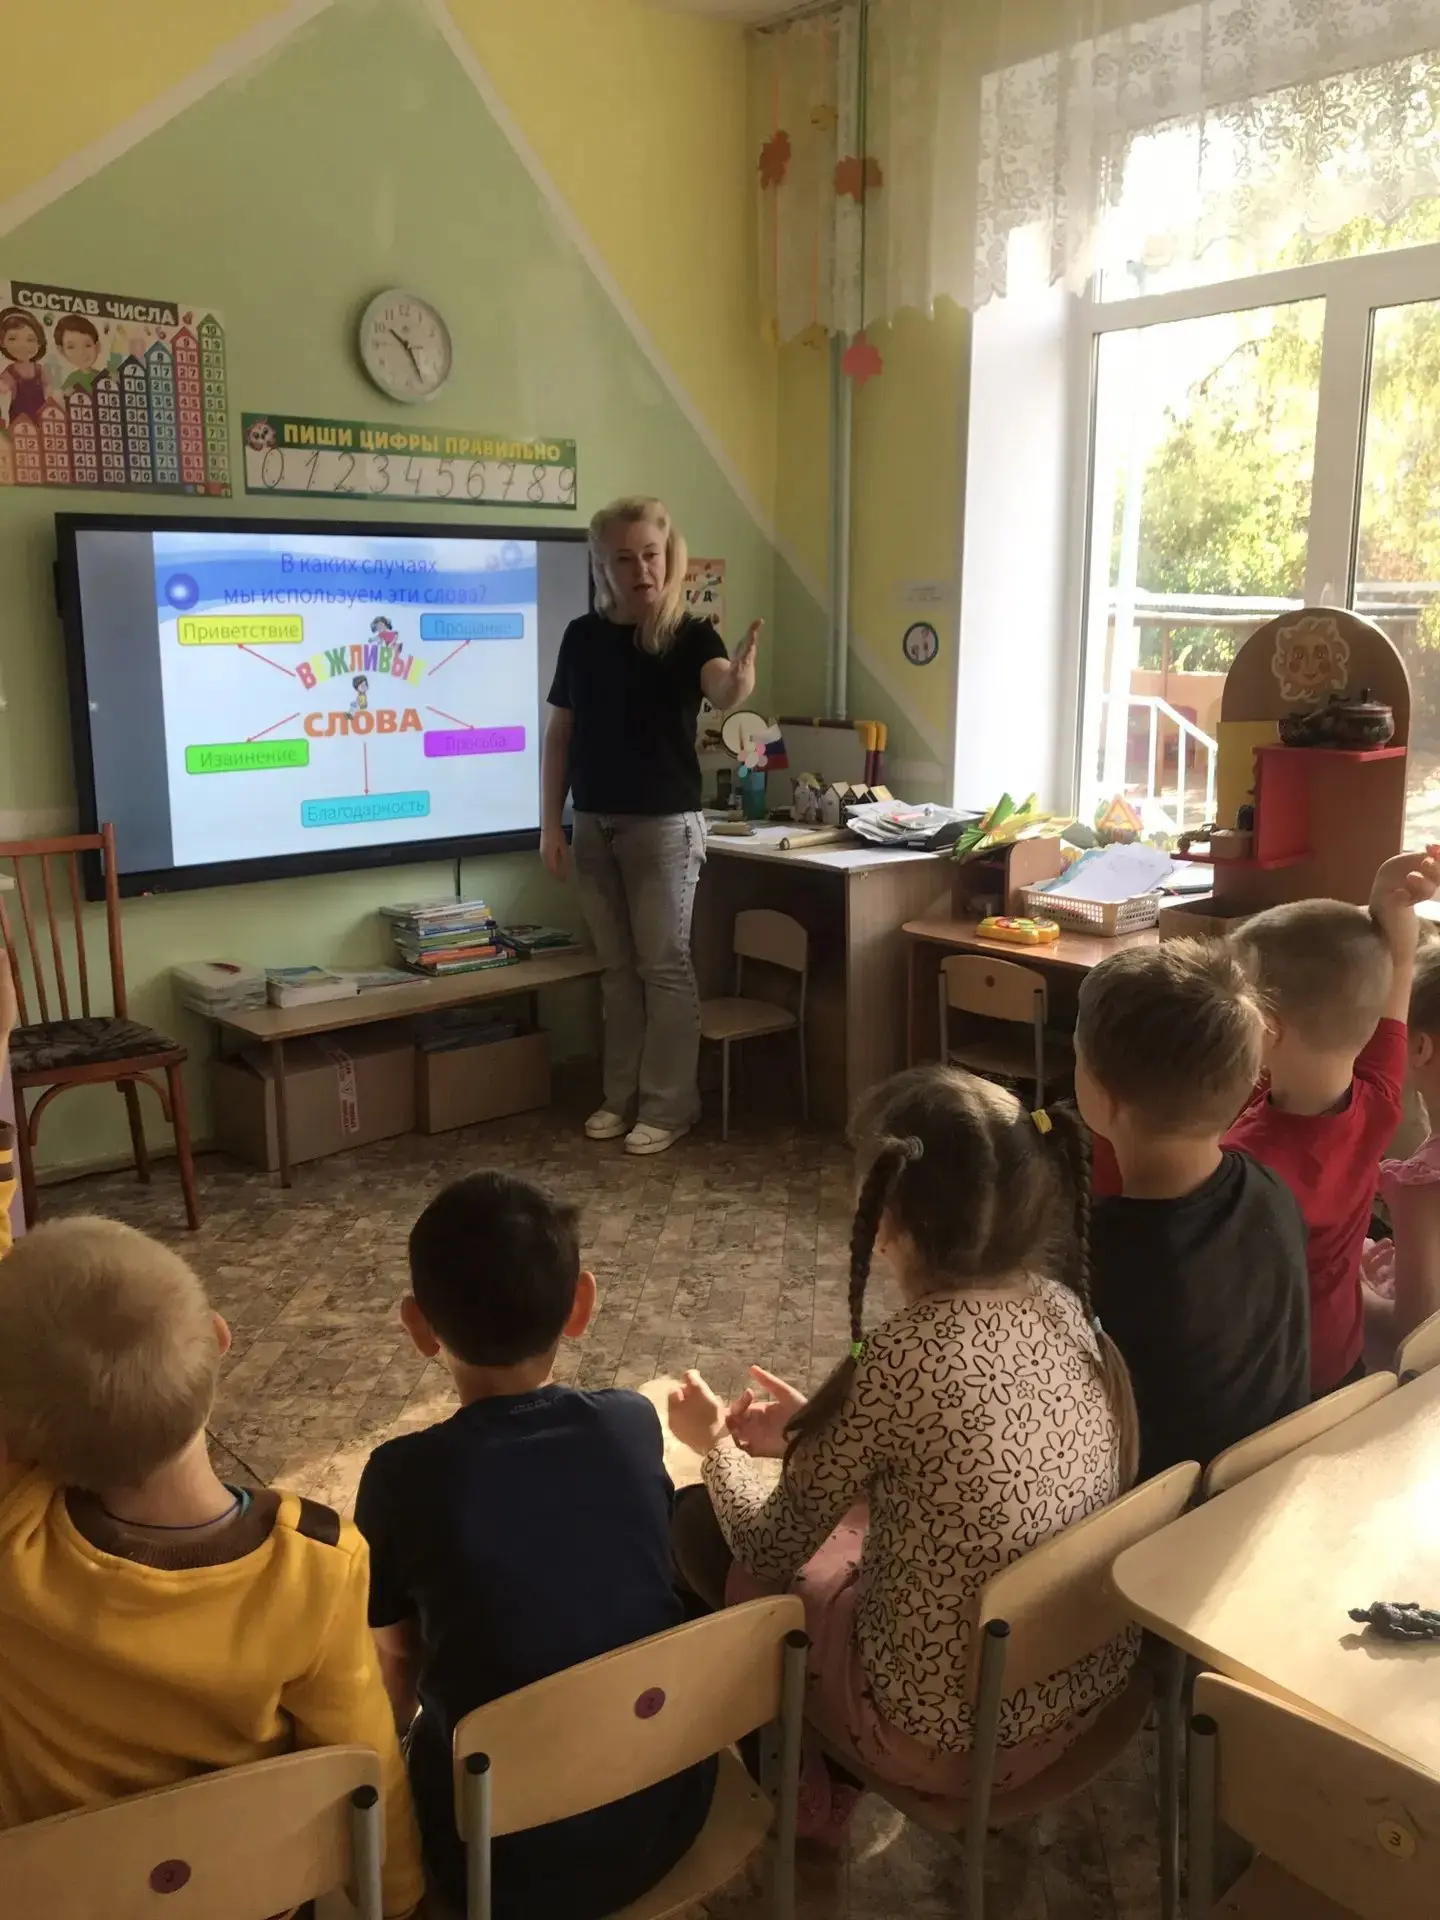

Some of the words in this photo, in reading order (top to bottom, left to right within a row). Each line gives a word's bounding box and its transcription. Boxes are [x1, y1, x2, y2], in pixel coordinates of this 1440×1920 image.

[17, 289, 100, 315] СОСТАВ
[105, 301, 176, 325] ЧИСЛА
[284, 423, 352, 446] ПИШИ
[359, 430, 439, 452] ЦИФРЫ
[445, 436, 560, 461] ПРАВИЛЬНО
[262, 447, 284, 489] 0
[305, 450, 319, 491] 1
[334, 451, 355, 492] 2
[369, 454, 390, 495] 3
[403, 456, 423, 496] 4
[436, 457, 454, 498] 5
[466, 460, 486, 499] 6
[497, 462, 516, 501] 7
[526, 464, 547, 502] 8
[557, 467, 575, 504] 9
[281, 553, 294, 573] В
[300, 557, 358, 574] каких
[362, 559, 438, 580] случаях
[224, 588, 255, 604] мы
[261, 587, 382, 609] используем
[387, 587, 420, 604] эти
[183, 623, 299, 643] Приветствие
[295, 643, 427, 690] ВЕЖЛИВЫЕ
[303, 708, 423, 737] СЛОВА
[200, 749, 298, 768] Извинение
[307, 799, 425, 822] Благодарность
[1389, 1830, 1401, 1847] 3
